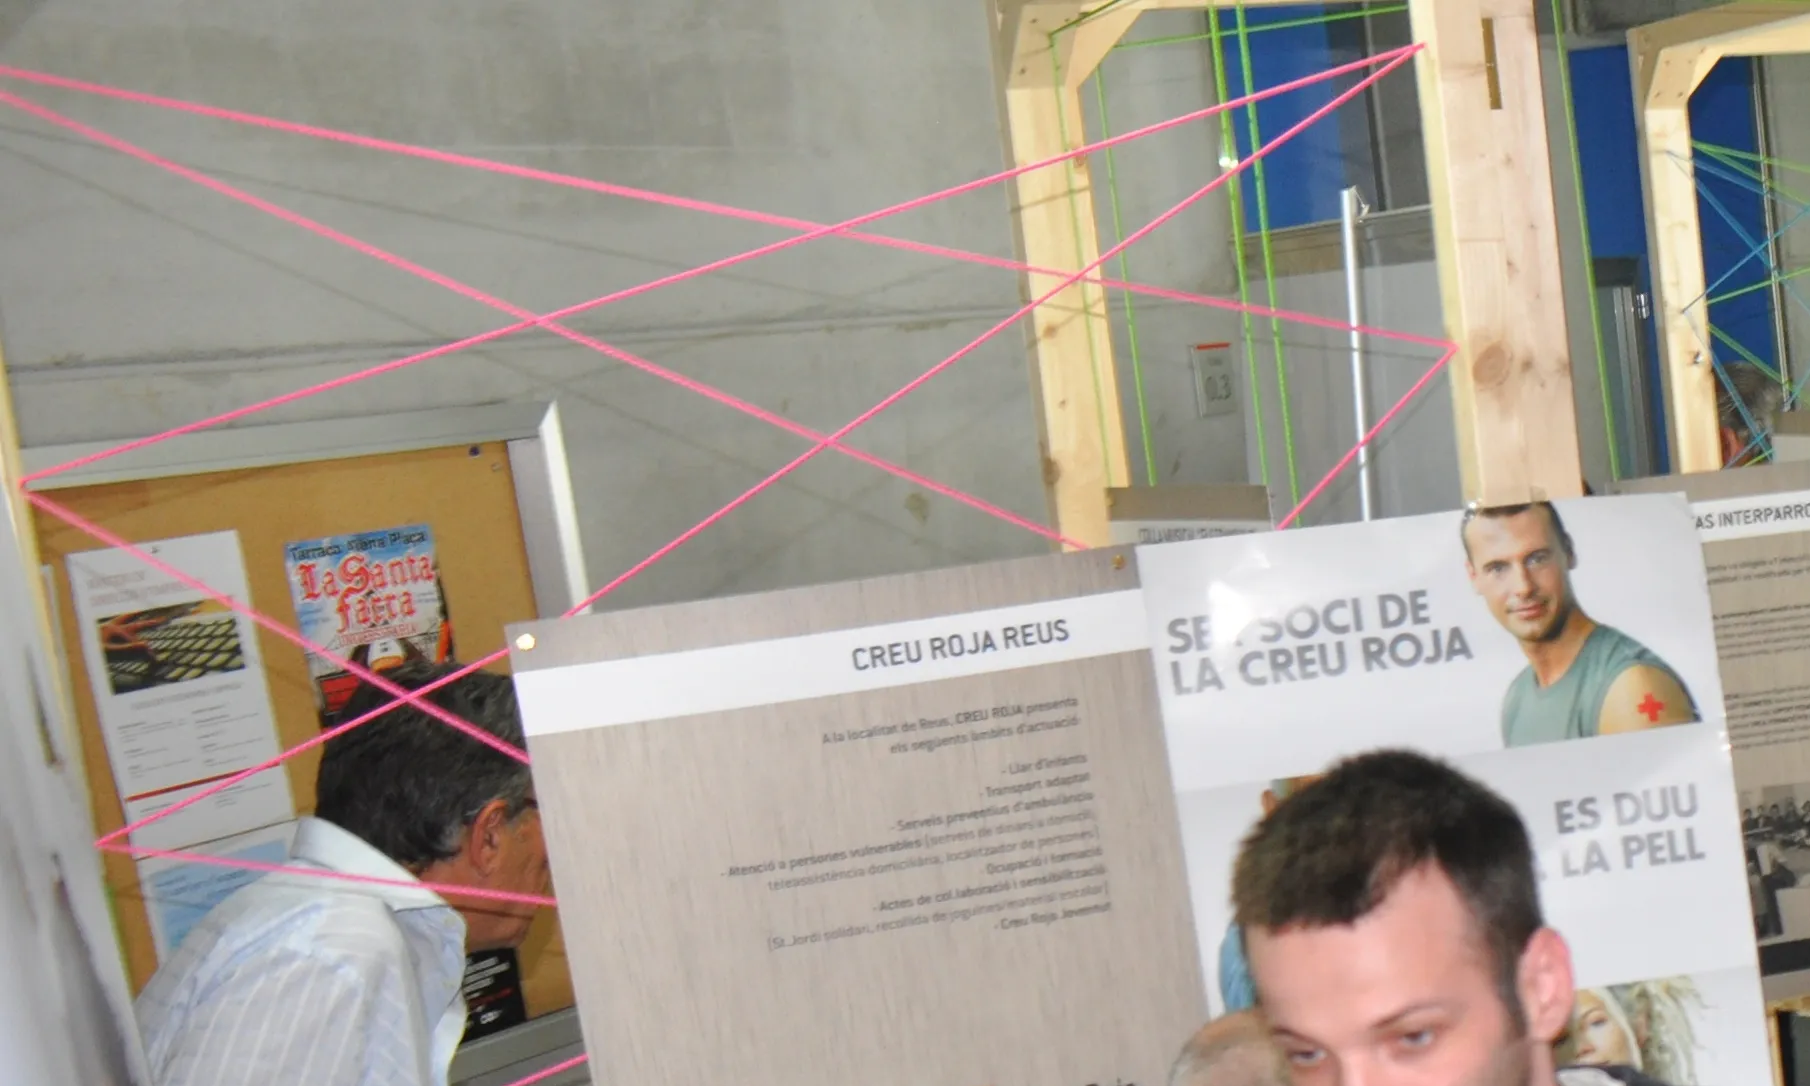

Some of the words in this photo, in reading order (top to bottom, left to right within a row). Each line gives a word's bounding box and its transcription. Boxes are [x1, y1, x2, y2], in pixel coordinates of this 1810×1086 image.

[294, 562, 341, 601] La
[339, 552, 436, 596] Santa
[1259, 598, 1364, 644] SOCI
[1377, 589, 1431, 629] DE
[851, 637, 923, 672] CREU
[930, 629, 998, 662] ROJA
[1002, 618, 1071, 652] REUS
[1170, 656, 1226, 696] LA
[1238, 640, 1348, 687] CREU
[1361, 625, 1475, 673] ROJA
[900, 721, 915, 733] de
[954, 710, 988, 725] CREU
[991, 705, 1023, 720] ROJA
[1026, 699, 1078, 716] presenta
[985, 778, 1041, 799] Transport
[1553, 796, 1602, 835] ES
[1612, 782, 1699, 826] DUU
[896, 814, 944, 831] Serveis
[789, 850, 847, 867] persones
[849, 836, 921, 857] vulnerables
[1561, 839, 1611, 878] LA
[1621, 827, 1706, 870] PELL
[879, 895, 914, 911] Actes
[916, 893, 931, 905] de
